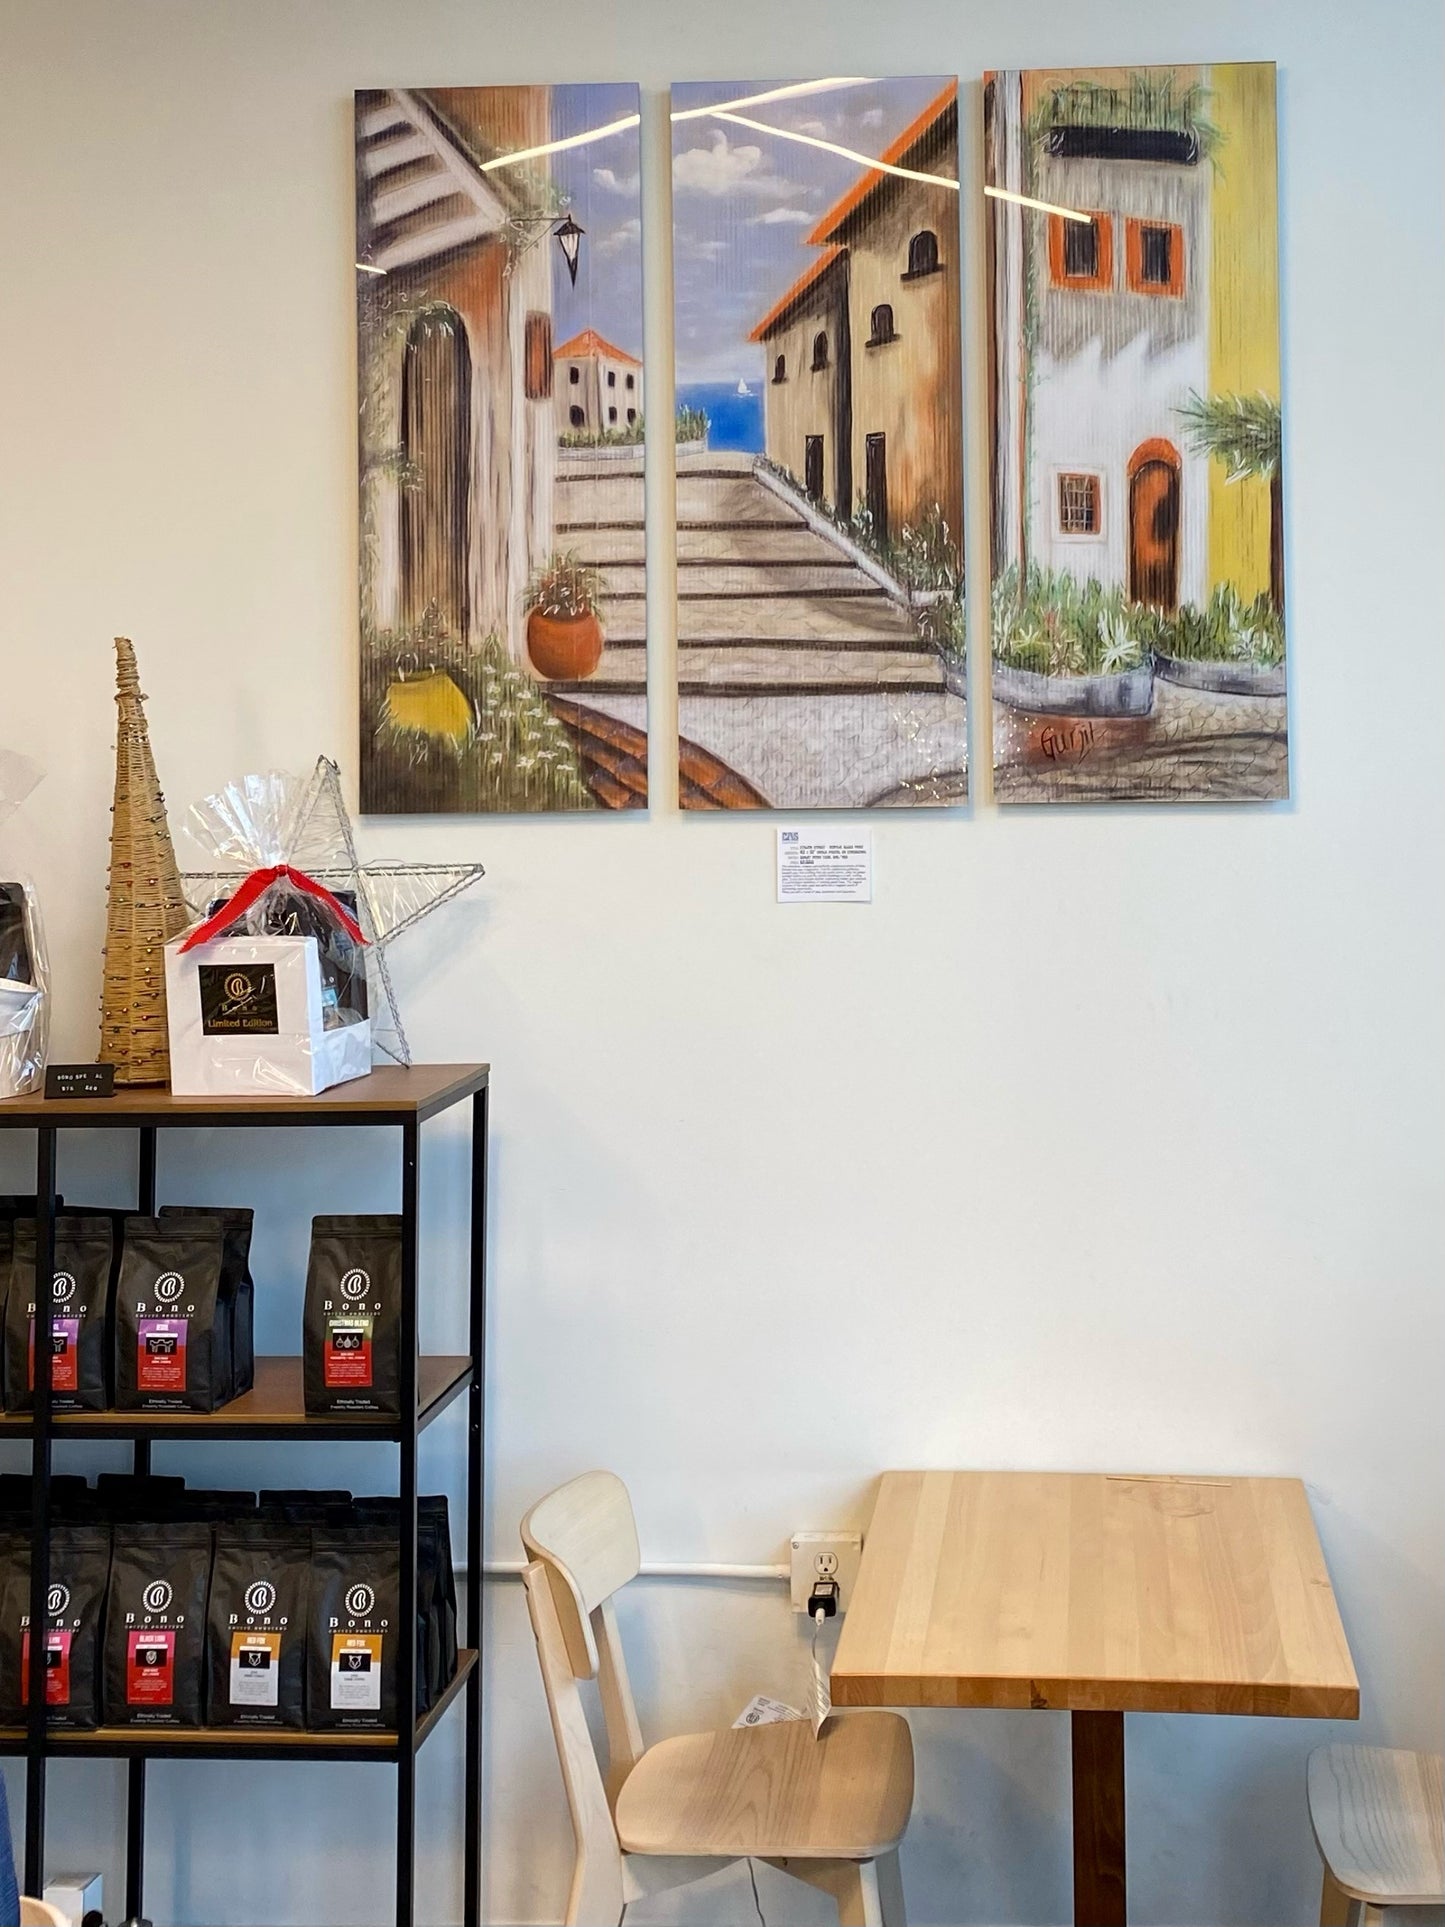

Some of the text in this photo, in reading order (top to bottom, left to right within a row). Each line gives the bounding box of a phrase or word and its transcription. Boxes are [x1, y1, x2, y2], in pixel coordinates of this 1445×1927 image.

[207, 1018, 273, 1028] Limited Edition
[27, 1303, 87, 1313] Bno
[136, 1302, 195, 1312] Bono
[324, 1300, 381, 1310] Bono
[20, 1616, 81, 1627] Bno
[126, 1613, 185, 1623] Bono
[229, 1614, 288, 1625] Bono
[329, 1617, 389, 1628] Bono
